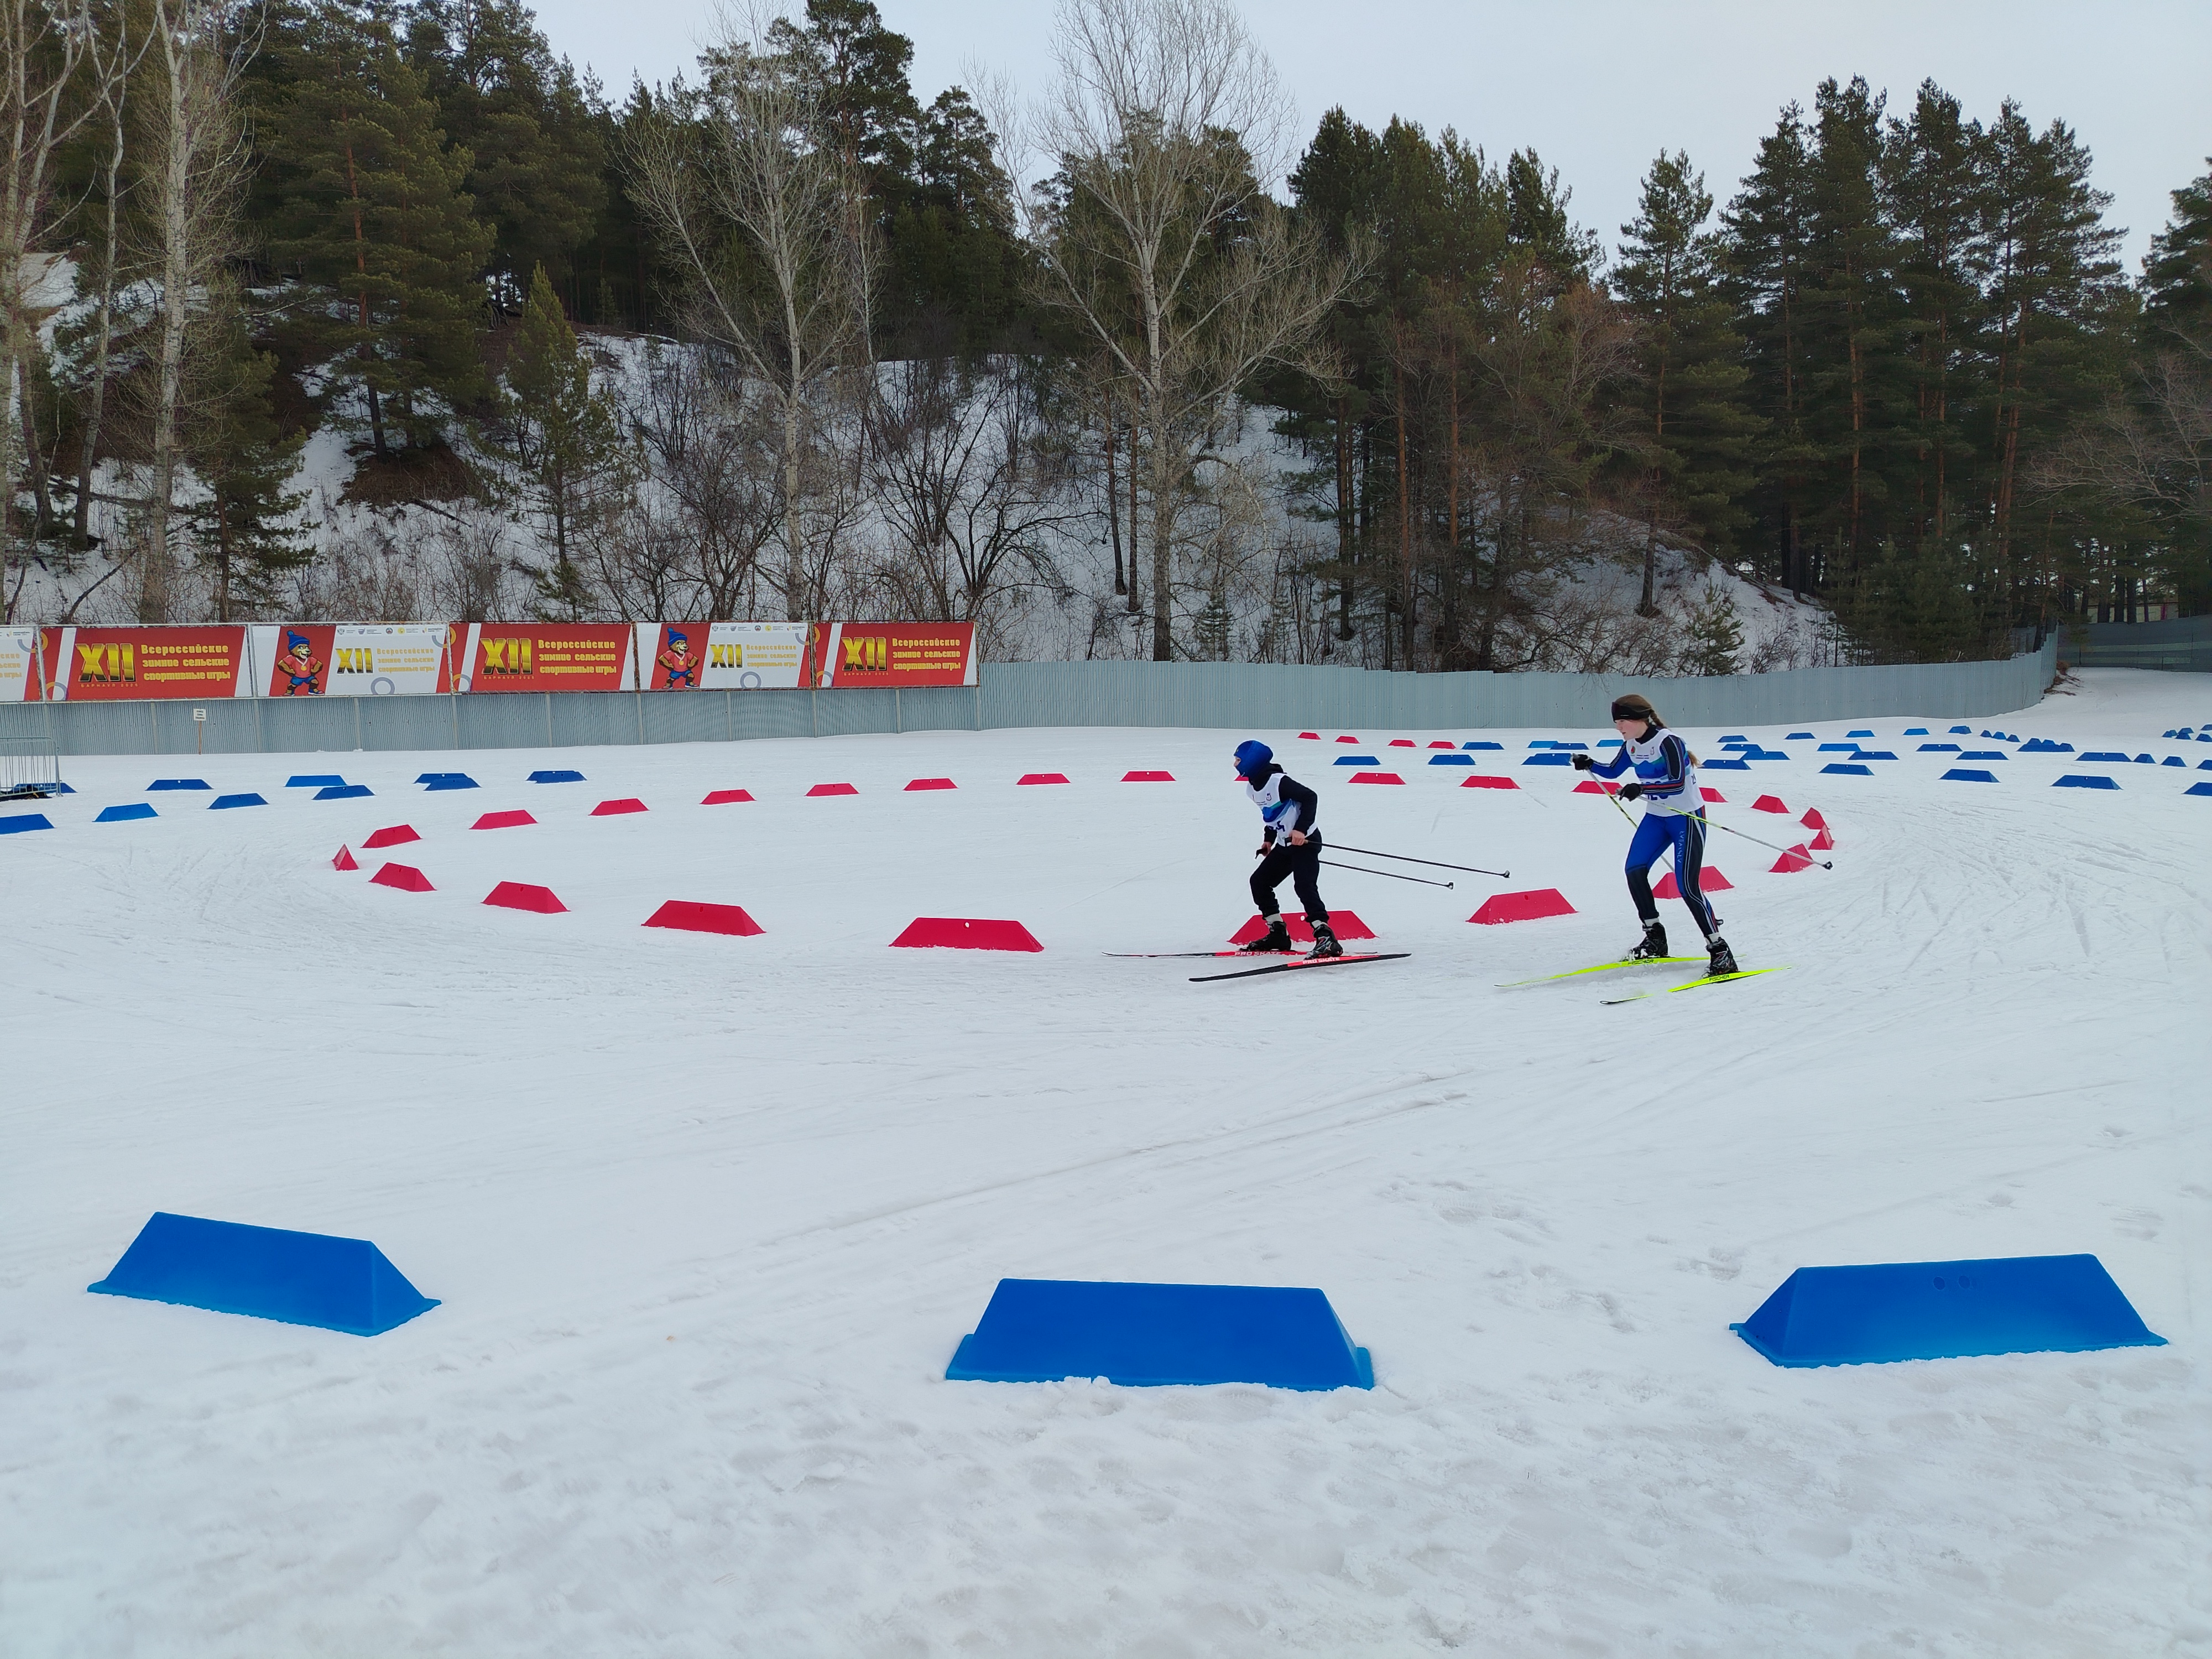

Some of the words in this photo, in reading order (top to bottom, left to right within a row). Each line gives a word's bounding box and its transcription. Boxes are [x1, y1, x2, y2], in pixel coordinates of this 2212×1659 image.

[538, 639, 615, 651] Всероссийские
[892, 638, 961, 648] Всероссийские
[141, 644, 228, 656] Всероссийские
[709, 644, 743, 668] XII
[841, 637, 887, 672] XII
[75, 643, 136, 682] XII
[182, 658, 229, 666] сельские
[335, 648, 373, 674] XII
[480, 638, 533, 675] XII
[539, 666, 594, 676] спортивные
[595, 666, 617, 675] игры
[893, 663, 942, 671] спортивные
[942, 662, 961, 671] игры
[144, 672, 206, 682] спортивные
[206, 671, 231, 681] игры
